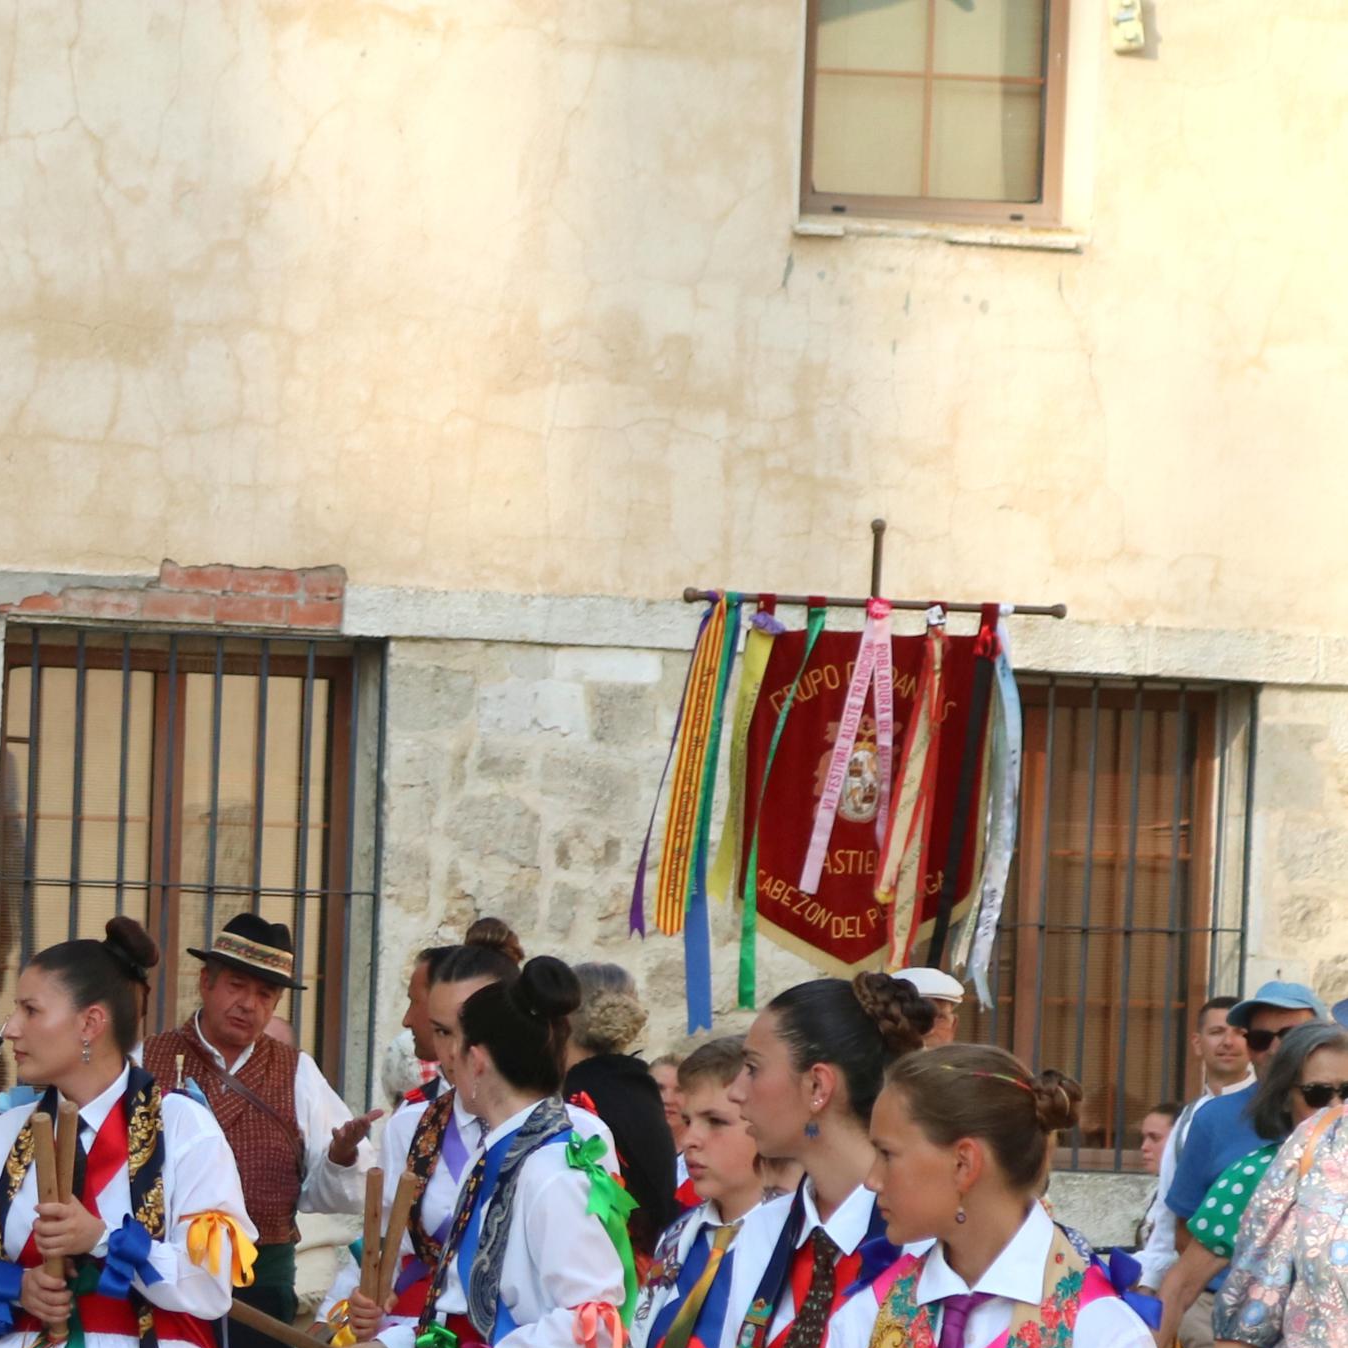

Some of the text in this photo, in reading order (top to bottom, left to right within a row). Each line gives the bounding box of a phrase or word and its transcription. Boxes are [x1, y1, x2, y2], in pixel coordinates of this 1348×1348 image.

[876, 642, 892, 714] POBLADURA
[878, 718, 892, 735] DE
[827, 745, 851, 795] FESTIVAL
